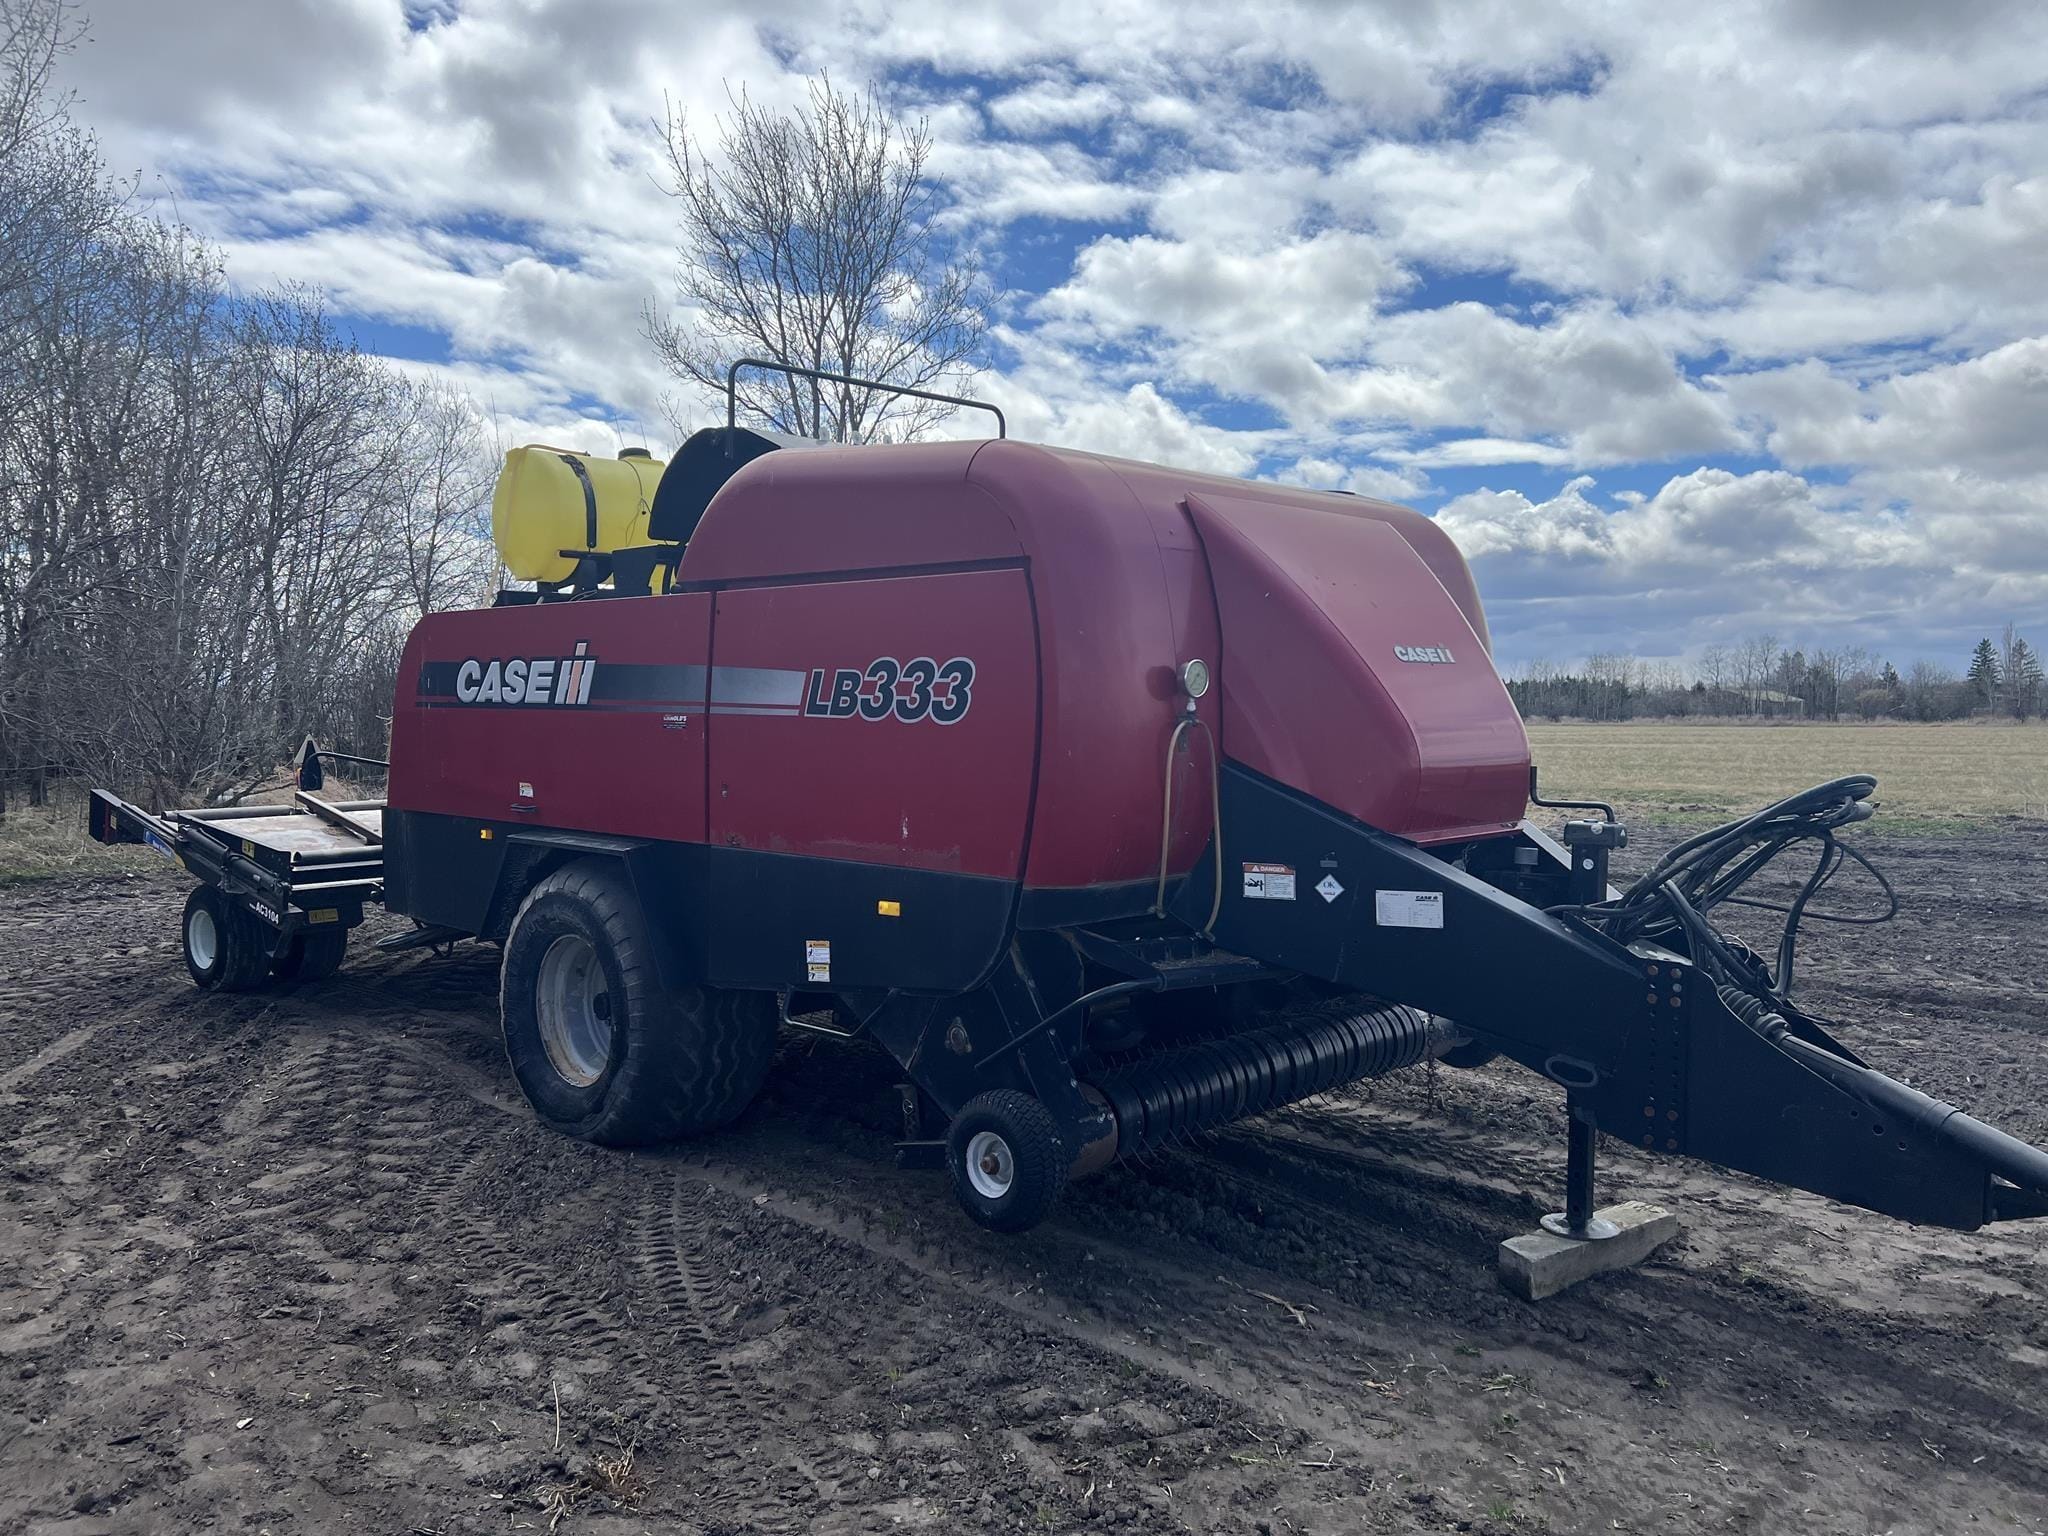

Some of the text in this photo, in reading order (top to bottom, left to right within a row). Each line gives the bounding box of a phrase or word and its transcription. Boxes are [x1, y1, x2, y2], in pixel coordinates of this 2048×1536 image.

[804, 656, 976, 726] LB333
[1260, 865, 1285, 873] DANGER
[1323, 880, 1335, 889] OK
[255, 901, 279, 924] AC3104
